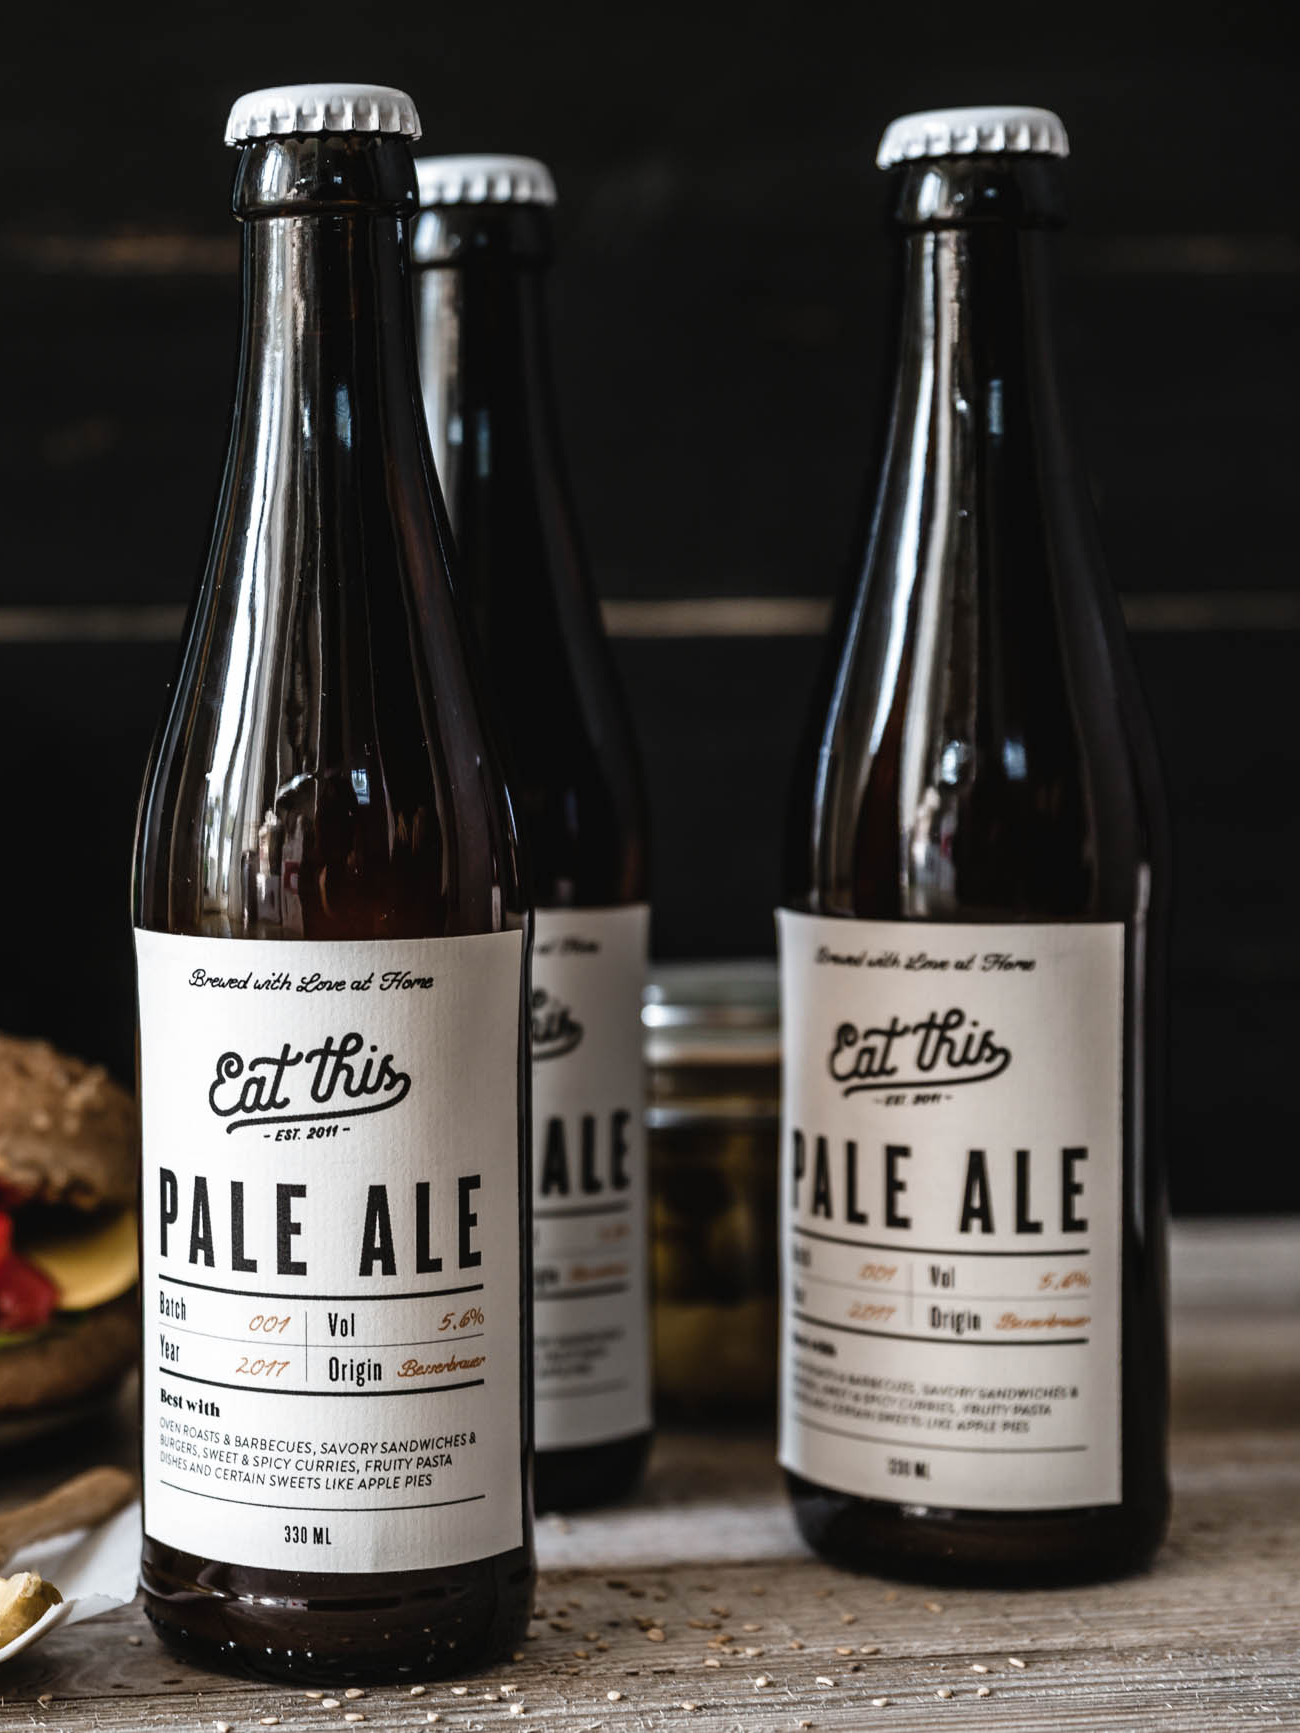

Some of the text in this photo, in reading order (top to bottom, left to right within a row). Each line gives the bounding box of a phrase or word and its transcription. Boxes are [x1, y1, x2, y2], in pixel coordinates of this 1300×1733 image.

[188, 968, 434, 993] Brewed with Love at Home
[828, 1007, 1012, 1082] Eat this
[209, 1032, 412, 1117] Eat this
[274, 1123, 339, 1142] EST. 2011
[539, 1108, 631, 1197] ALE
[792, 1127, 1090, 1236] PALE ALE
[159, 1166, 483, 1277] PALE ALE
[929, 1264, 956, 1289] Vol
[159, 1290, 292, 1334] Batch 001
[327, 1306, 485, 1338] Vol 5.6%
[929, 1305, 982, 1335] Origin
[159, 1333, 291, 1377] Year 2017
[328, 1354, 486, 1388] Origin Besserbrauer
[160, 1387, 221, 1418] Best with
[159, 1416, 477, 1457] OVEN ROASTS & BARBECUES, SAVORY SANDWICHES &
[159, 1433, 453, 1475] BURGERS, SWEET & SPICY CURRIES, FRUITY PASTA
[159, 1450, 433, 1491] DISHES AND CERTAIN SWEETS LIKE APPLE PIES
[284, 1525, 333, 1546] 330 ML
